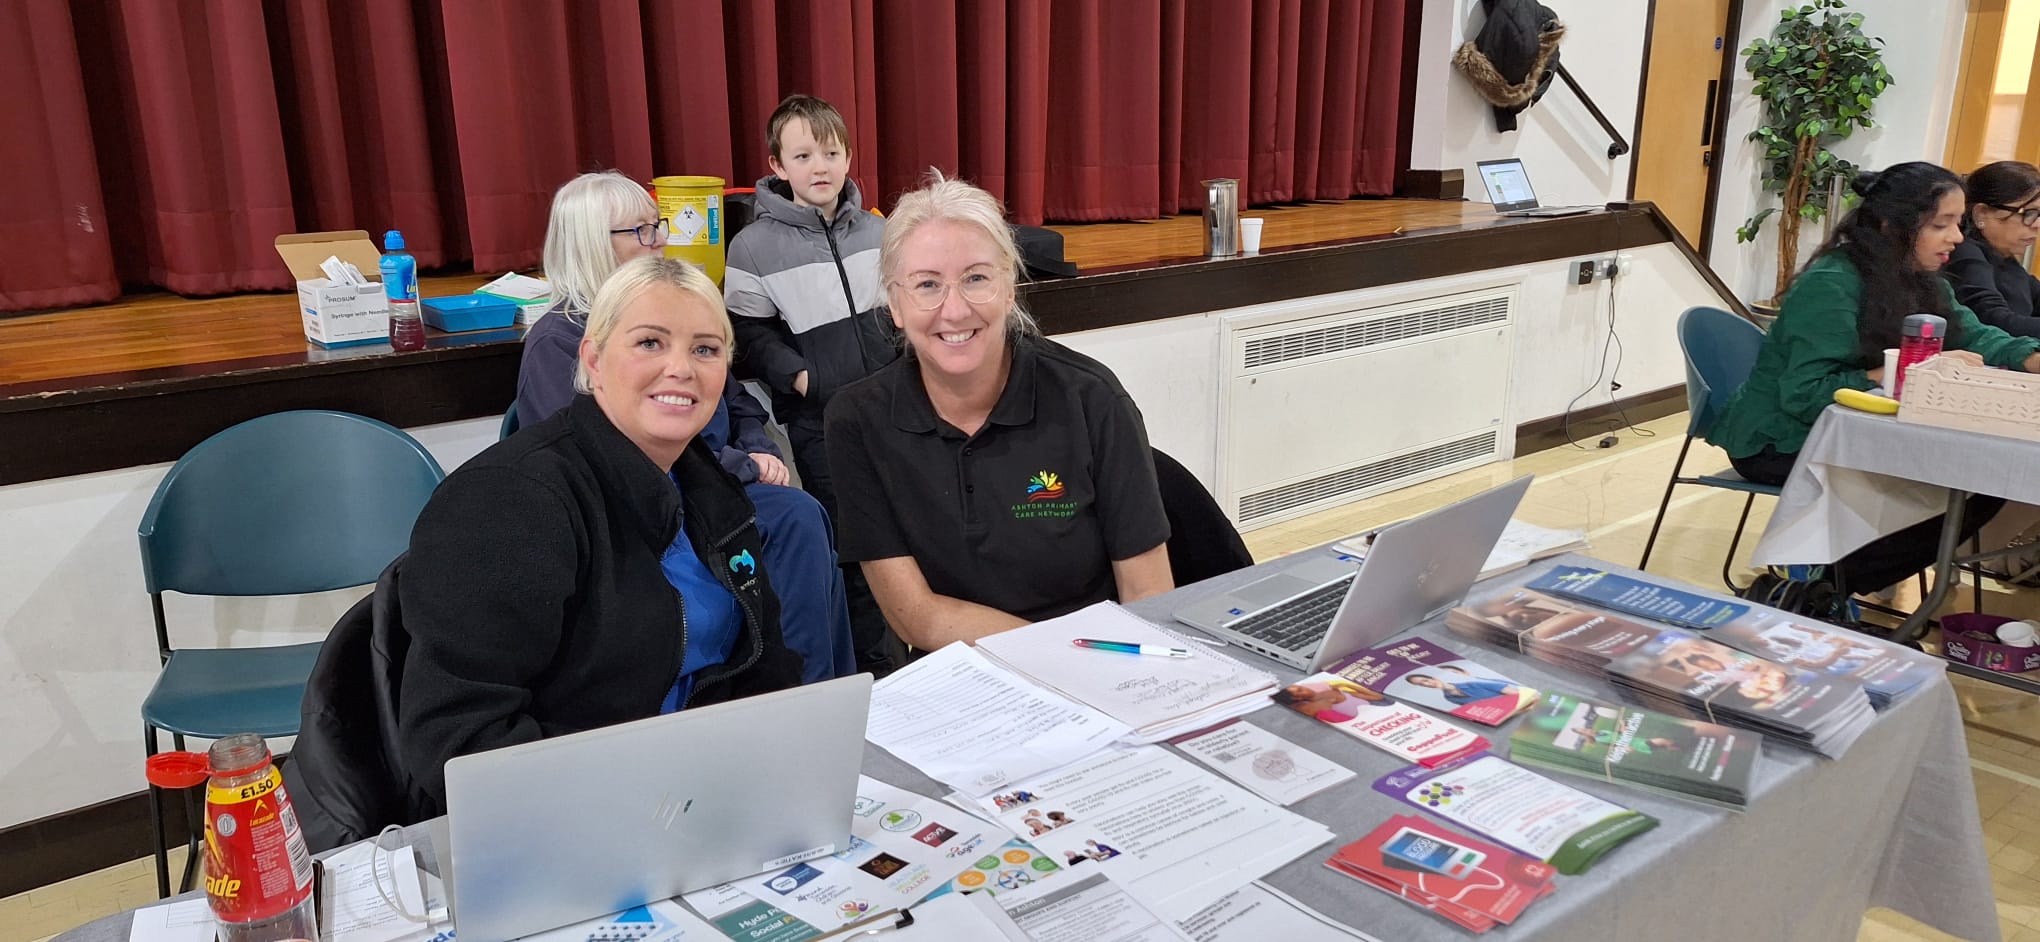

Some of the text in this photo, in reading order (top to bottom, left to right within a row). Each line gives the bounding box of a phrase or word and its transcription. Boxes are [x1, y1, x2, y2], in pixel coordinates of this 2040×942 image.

[331, 312, 353, 320] Syringe
[1011, 503, 1042, 511] ASHTON
[1015, 511, 1036, 519] CARE
[1369, 712, 1422, 736] CHECKING
[241, 779, 273, 799] £1.50
[738, 913, 768, 929] Hyde
[750, 920, 784, 938] Social
